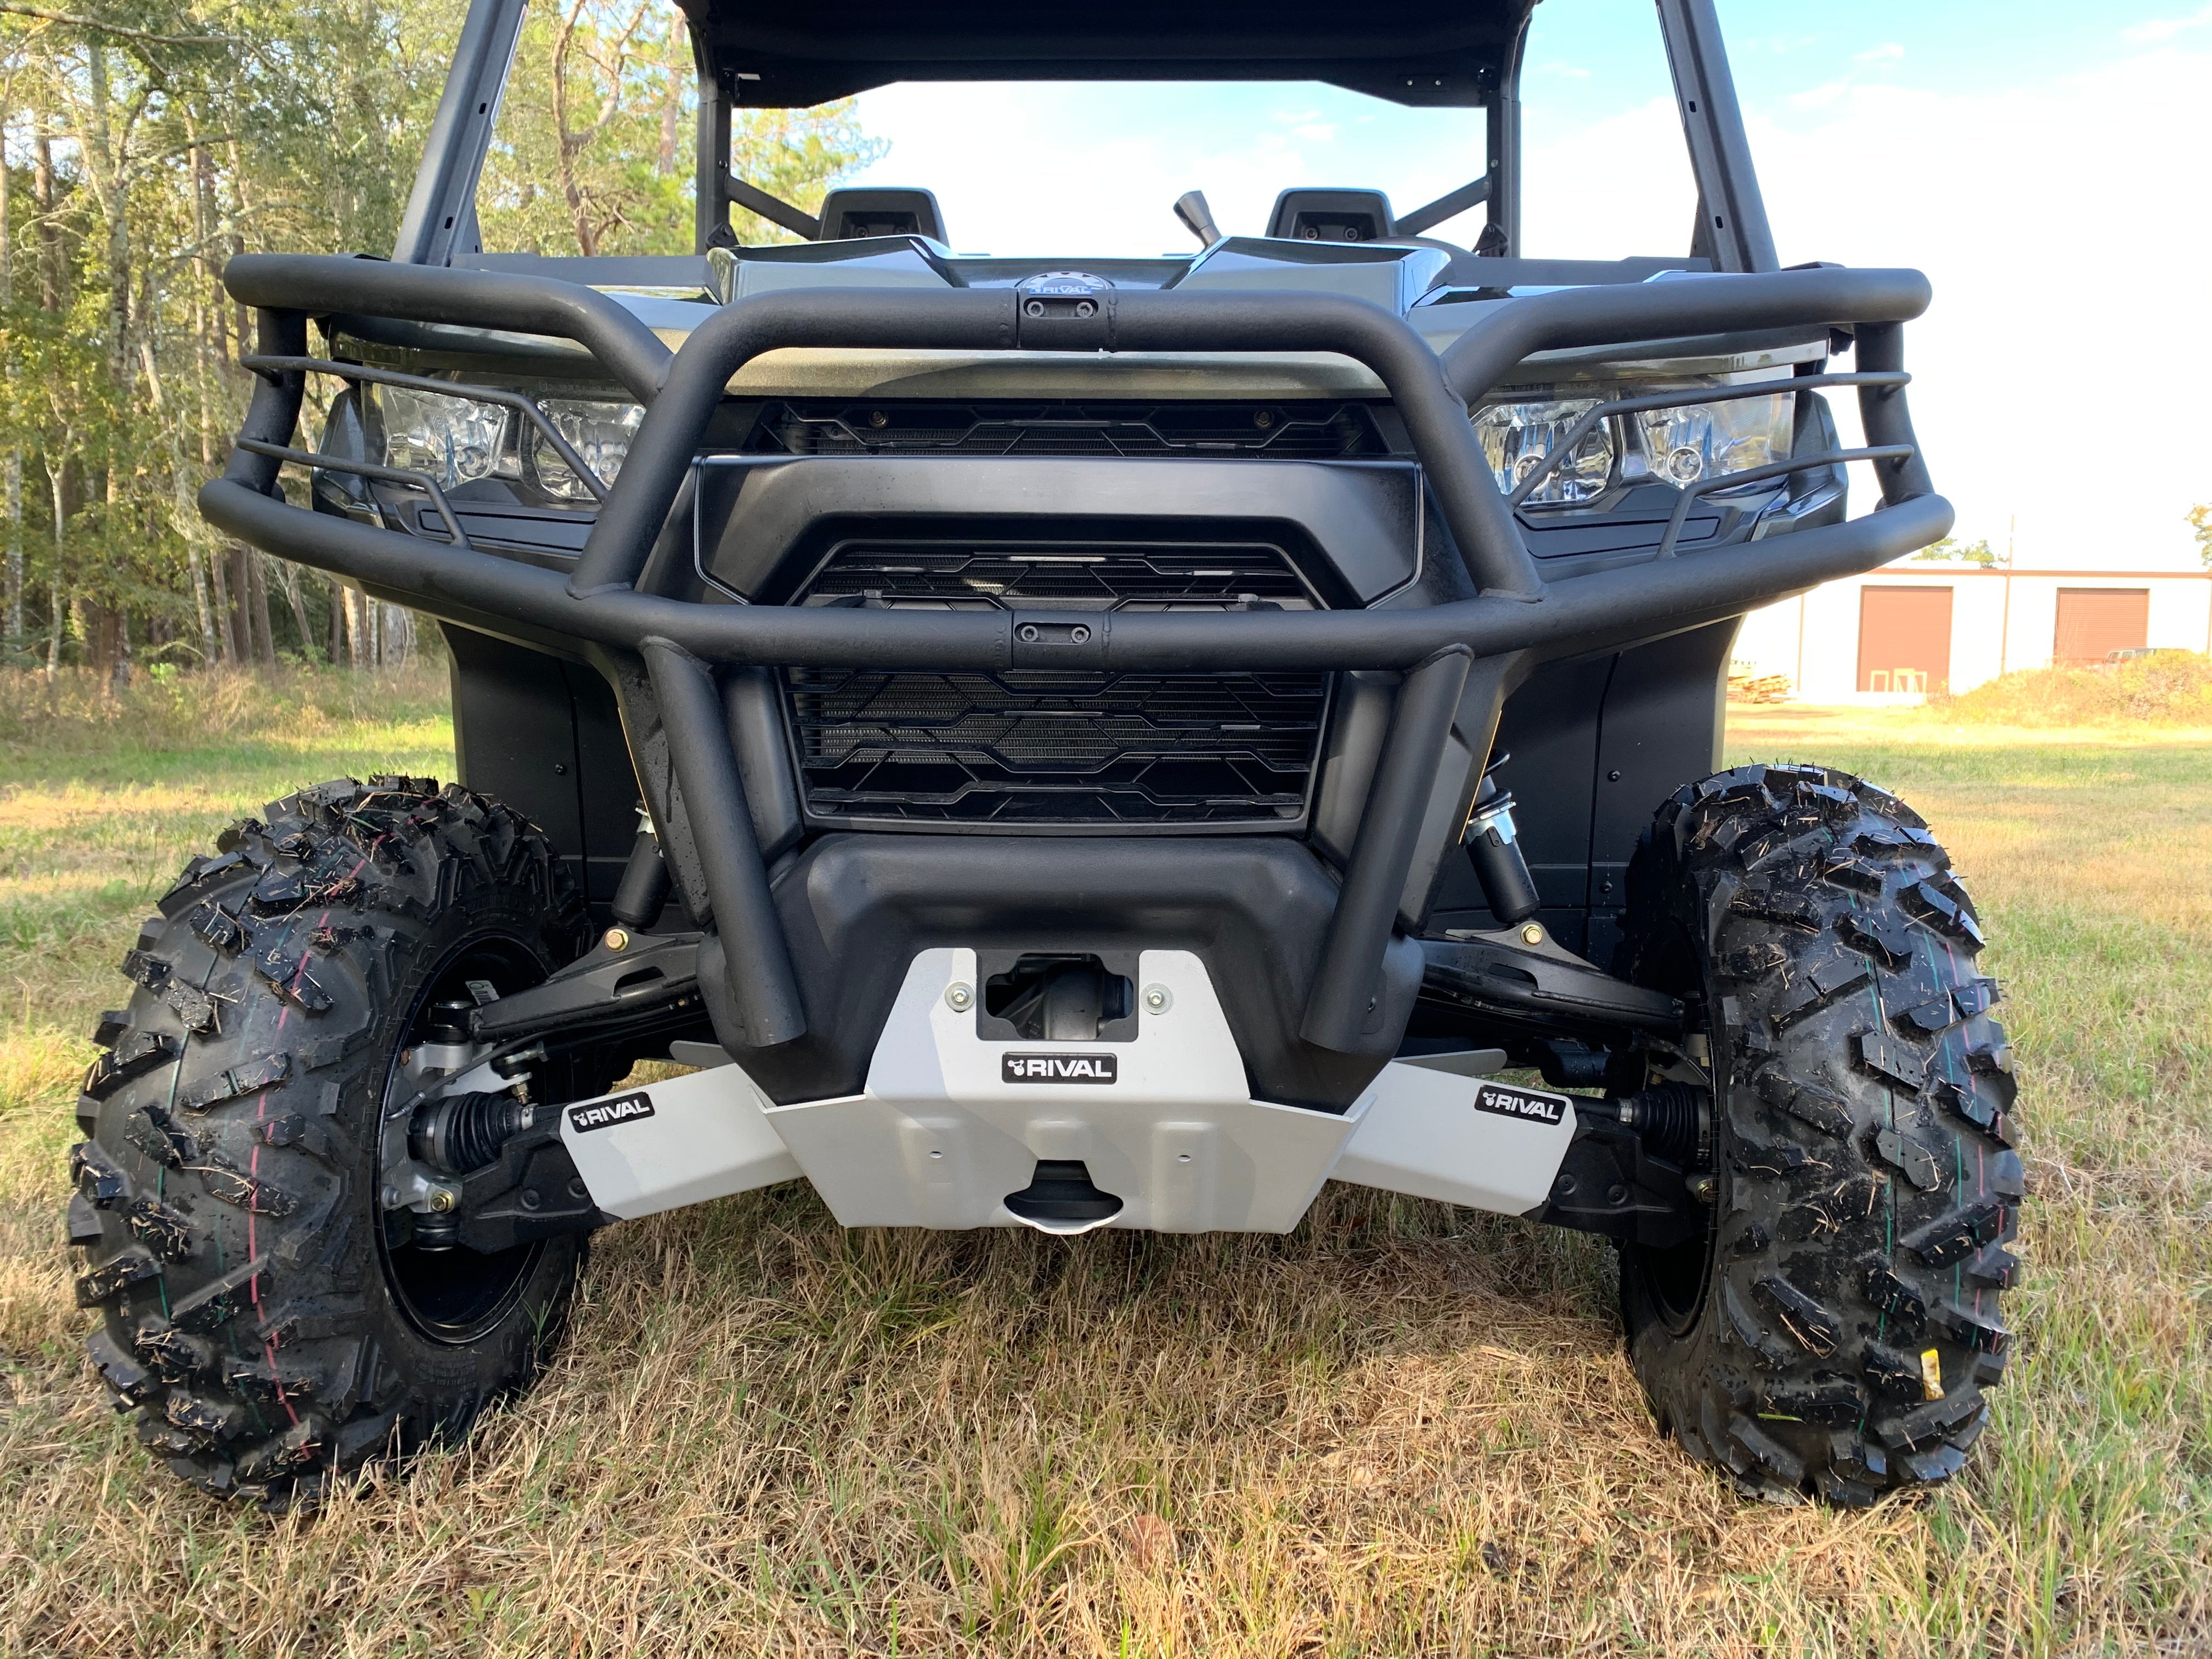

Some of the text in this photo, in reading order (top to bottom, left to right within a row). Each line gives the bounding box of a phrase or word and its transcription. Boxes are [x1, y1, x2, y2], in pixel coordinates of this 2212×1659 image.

[1027, 1059, 1112, 1077] RIVAL
[586, 1099, 650, 1125] RIVAL
[1494, 1094, 1559, 1120] RIVAL
